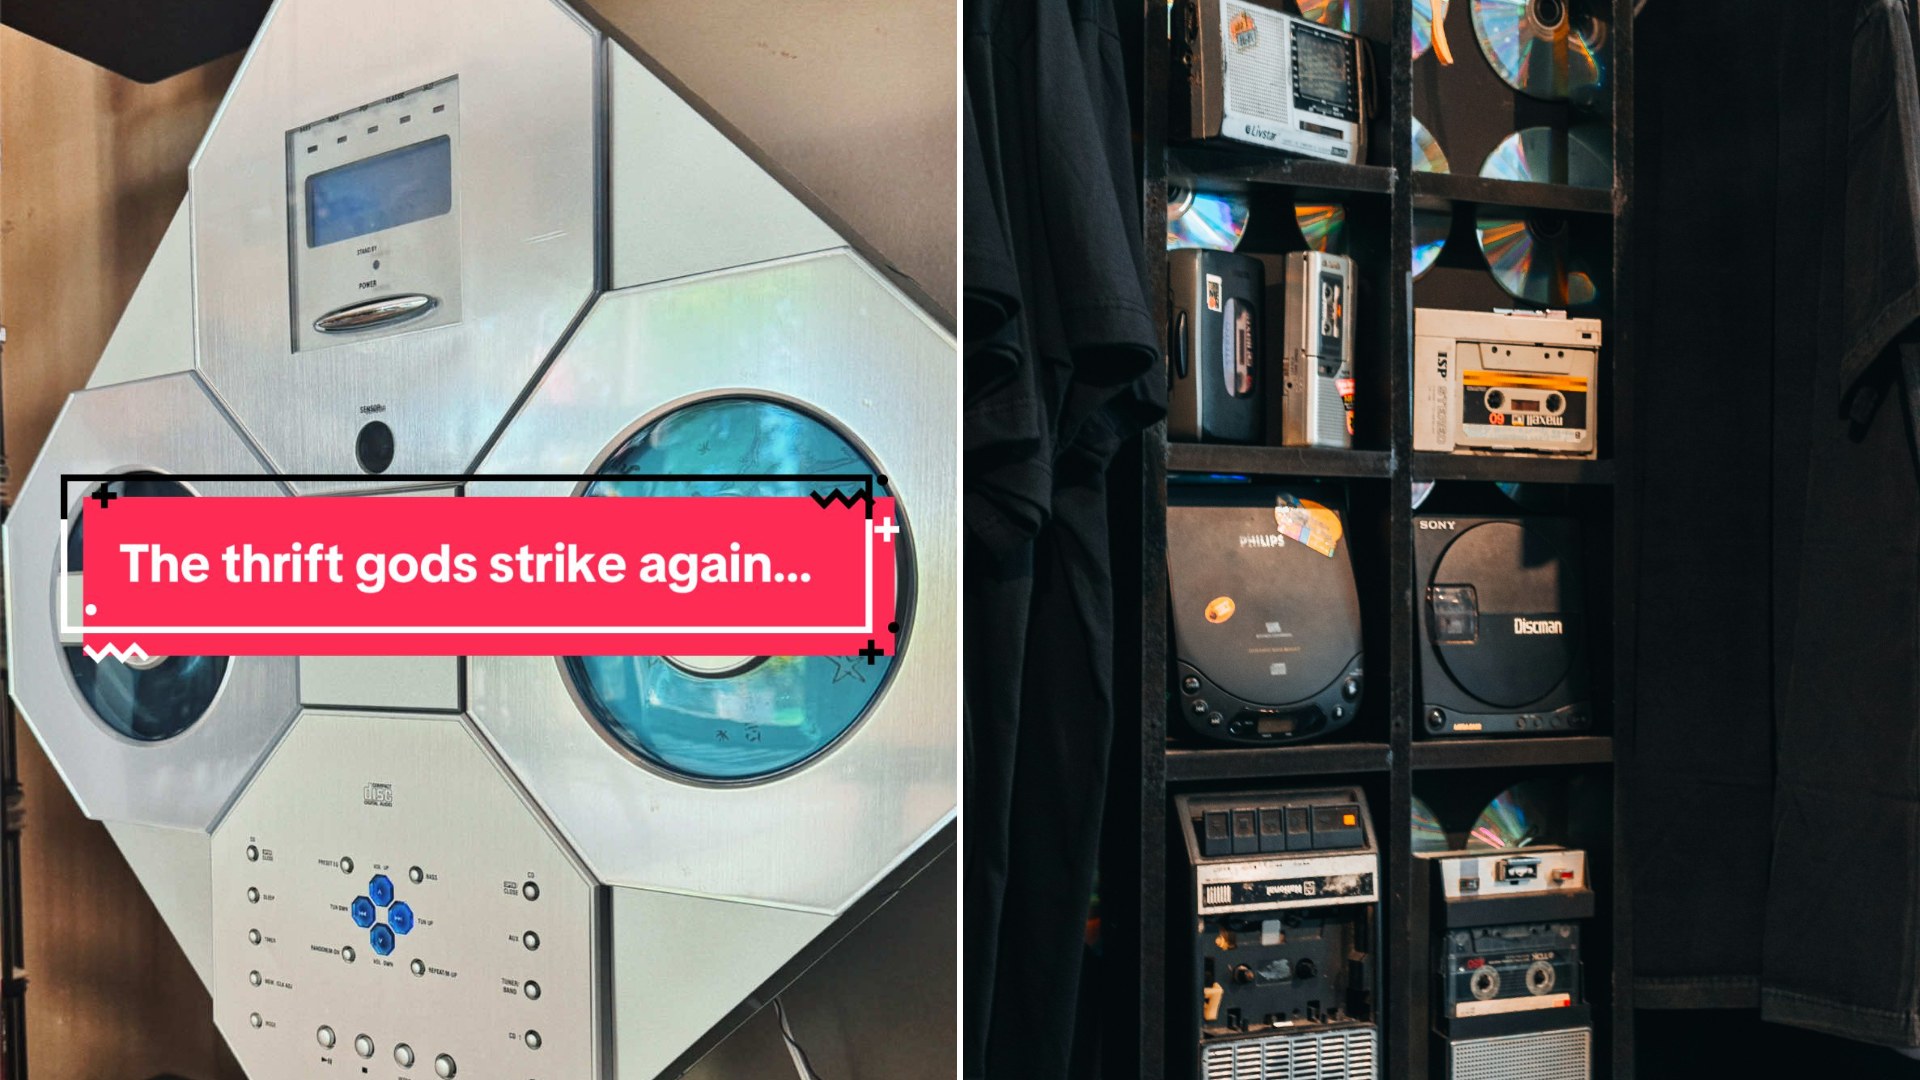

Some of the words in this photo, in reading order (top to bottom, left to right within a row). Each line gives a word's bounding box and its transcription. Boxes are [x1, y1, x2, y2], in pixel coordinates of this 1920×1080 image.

[359, 280, 377, 289] POWER
[1437, 352, 1447, 378] ISP
[1489, 412, 1505, 425] 60
[1526, 414, 1564, 426] maxell
[1419, 520, 1456, 530] SONY
[1239, 534, 1285, 548] PHILIPS
[1513, 618, 1563, 635] Discman
[504, 888, 519, 896] CLOSE
